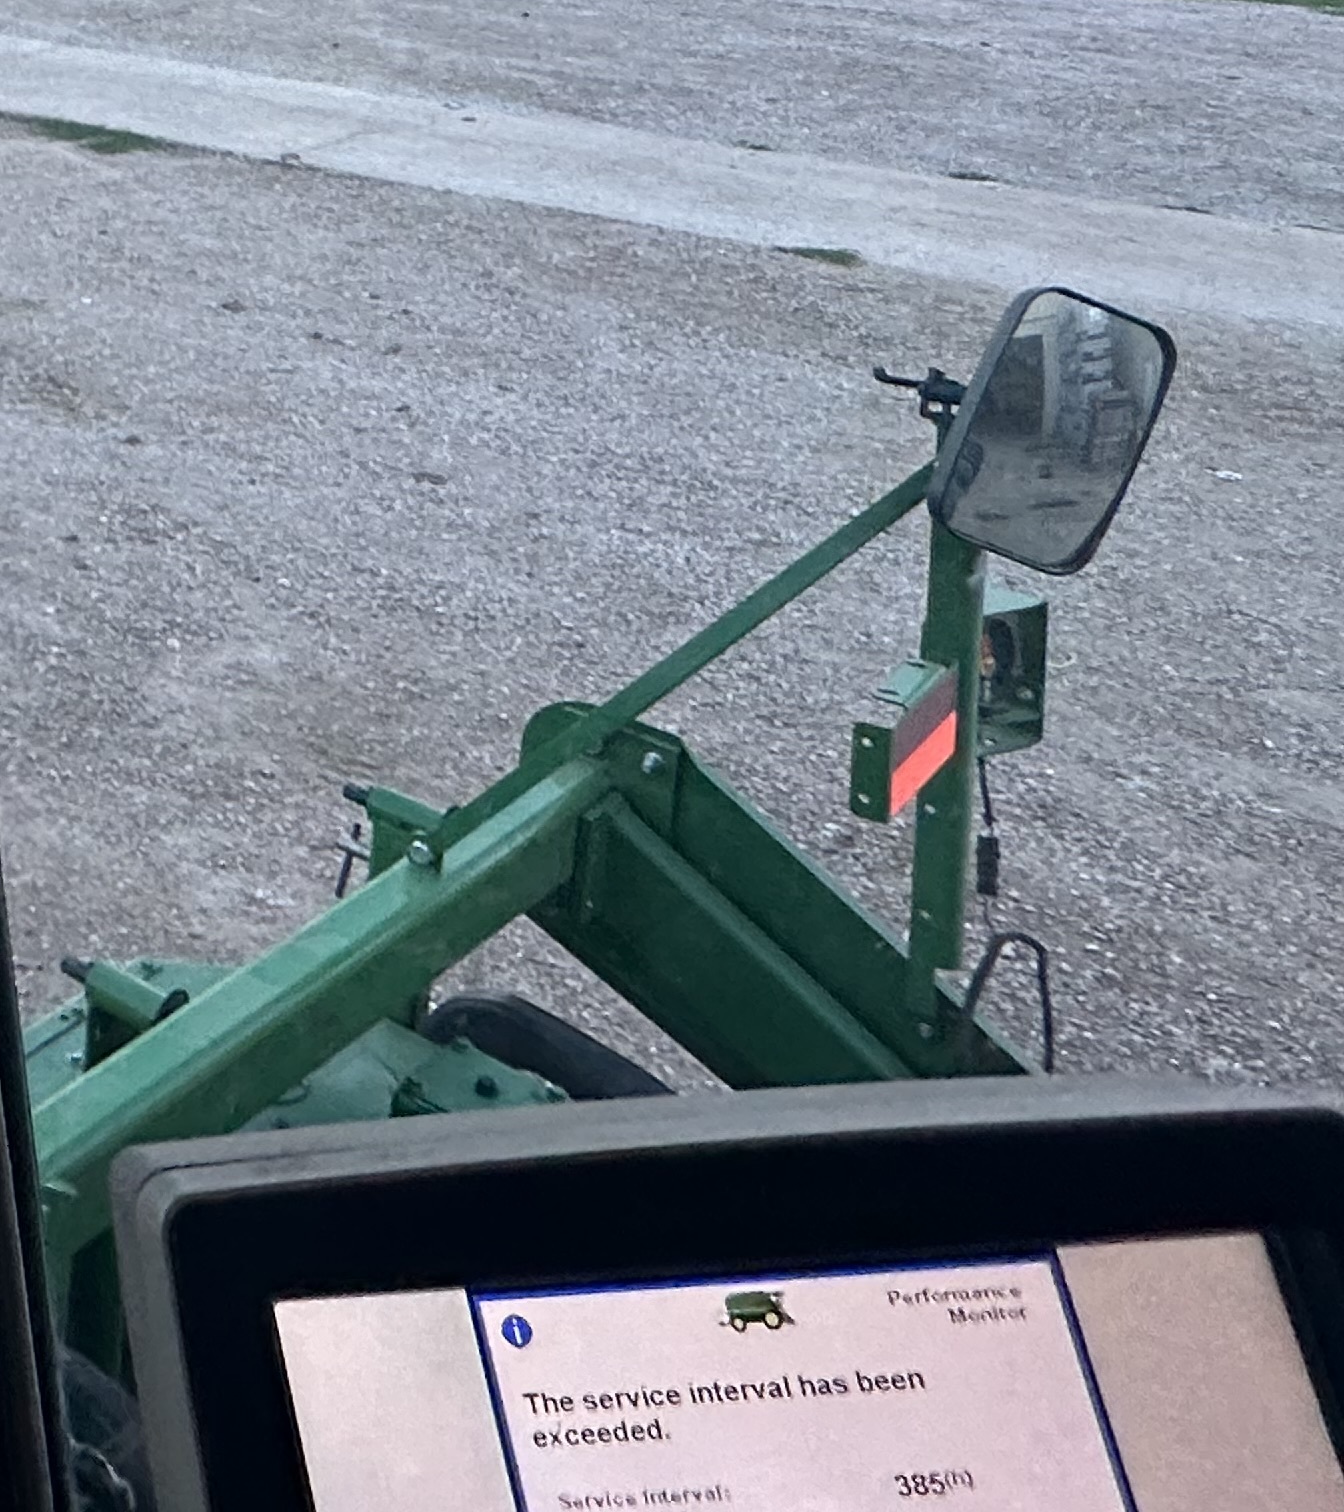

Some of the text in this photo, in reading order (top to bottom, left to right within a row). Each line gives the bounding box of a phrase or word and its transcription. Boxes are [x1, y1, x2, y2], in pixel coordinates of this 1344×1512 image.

[886, 1287, 1023, 1307] Performance
[947, 1306, 1027, 1324] Monitor
[522, 1370, 927, 1415] The service interval has been
[533, 1419, 672, 1448] exceeded.
[557, 1492, 638, 1510] Service
